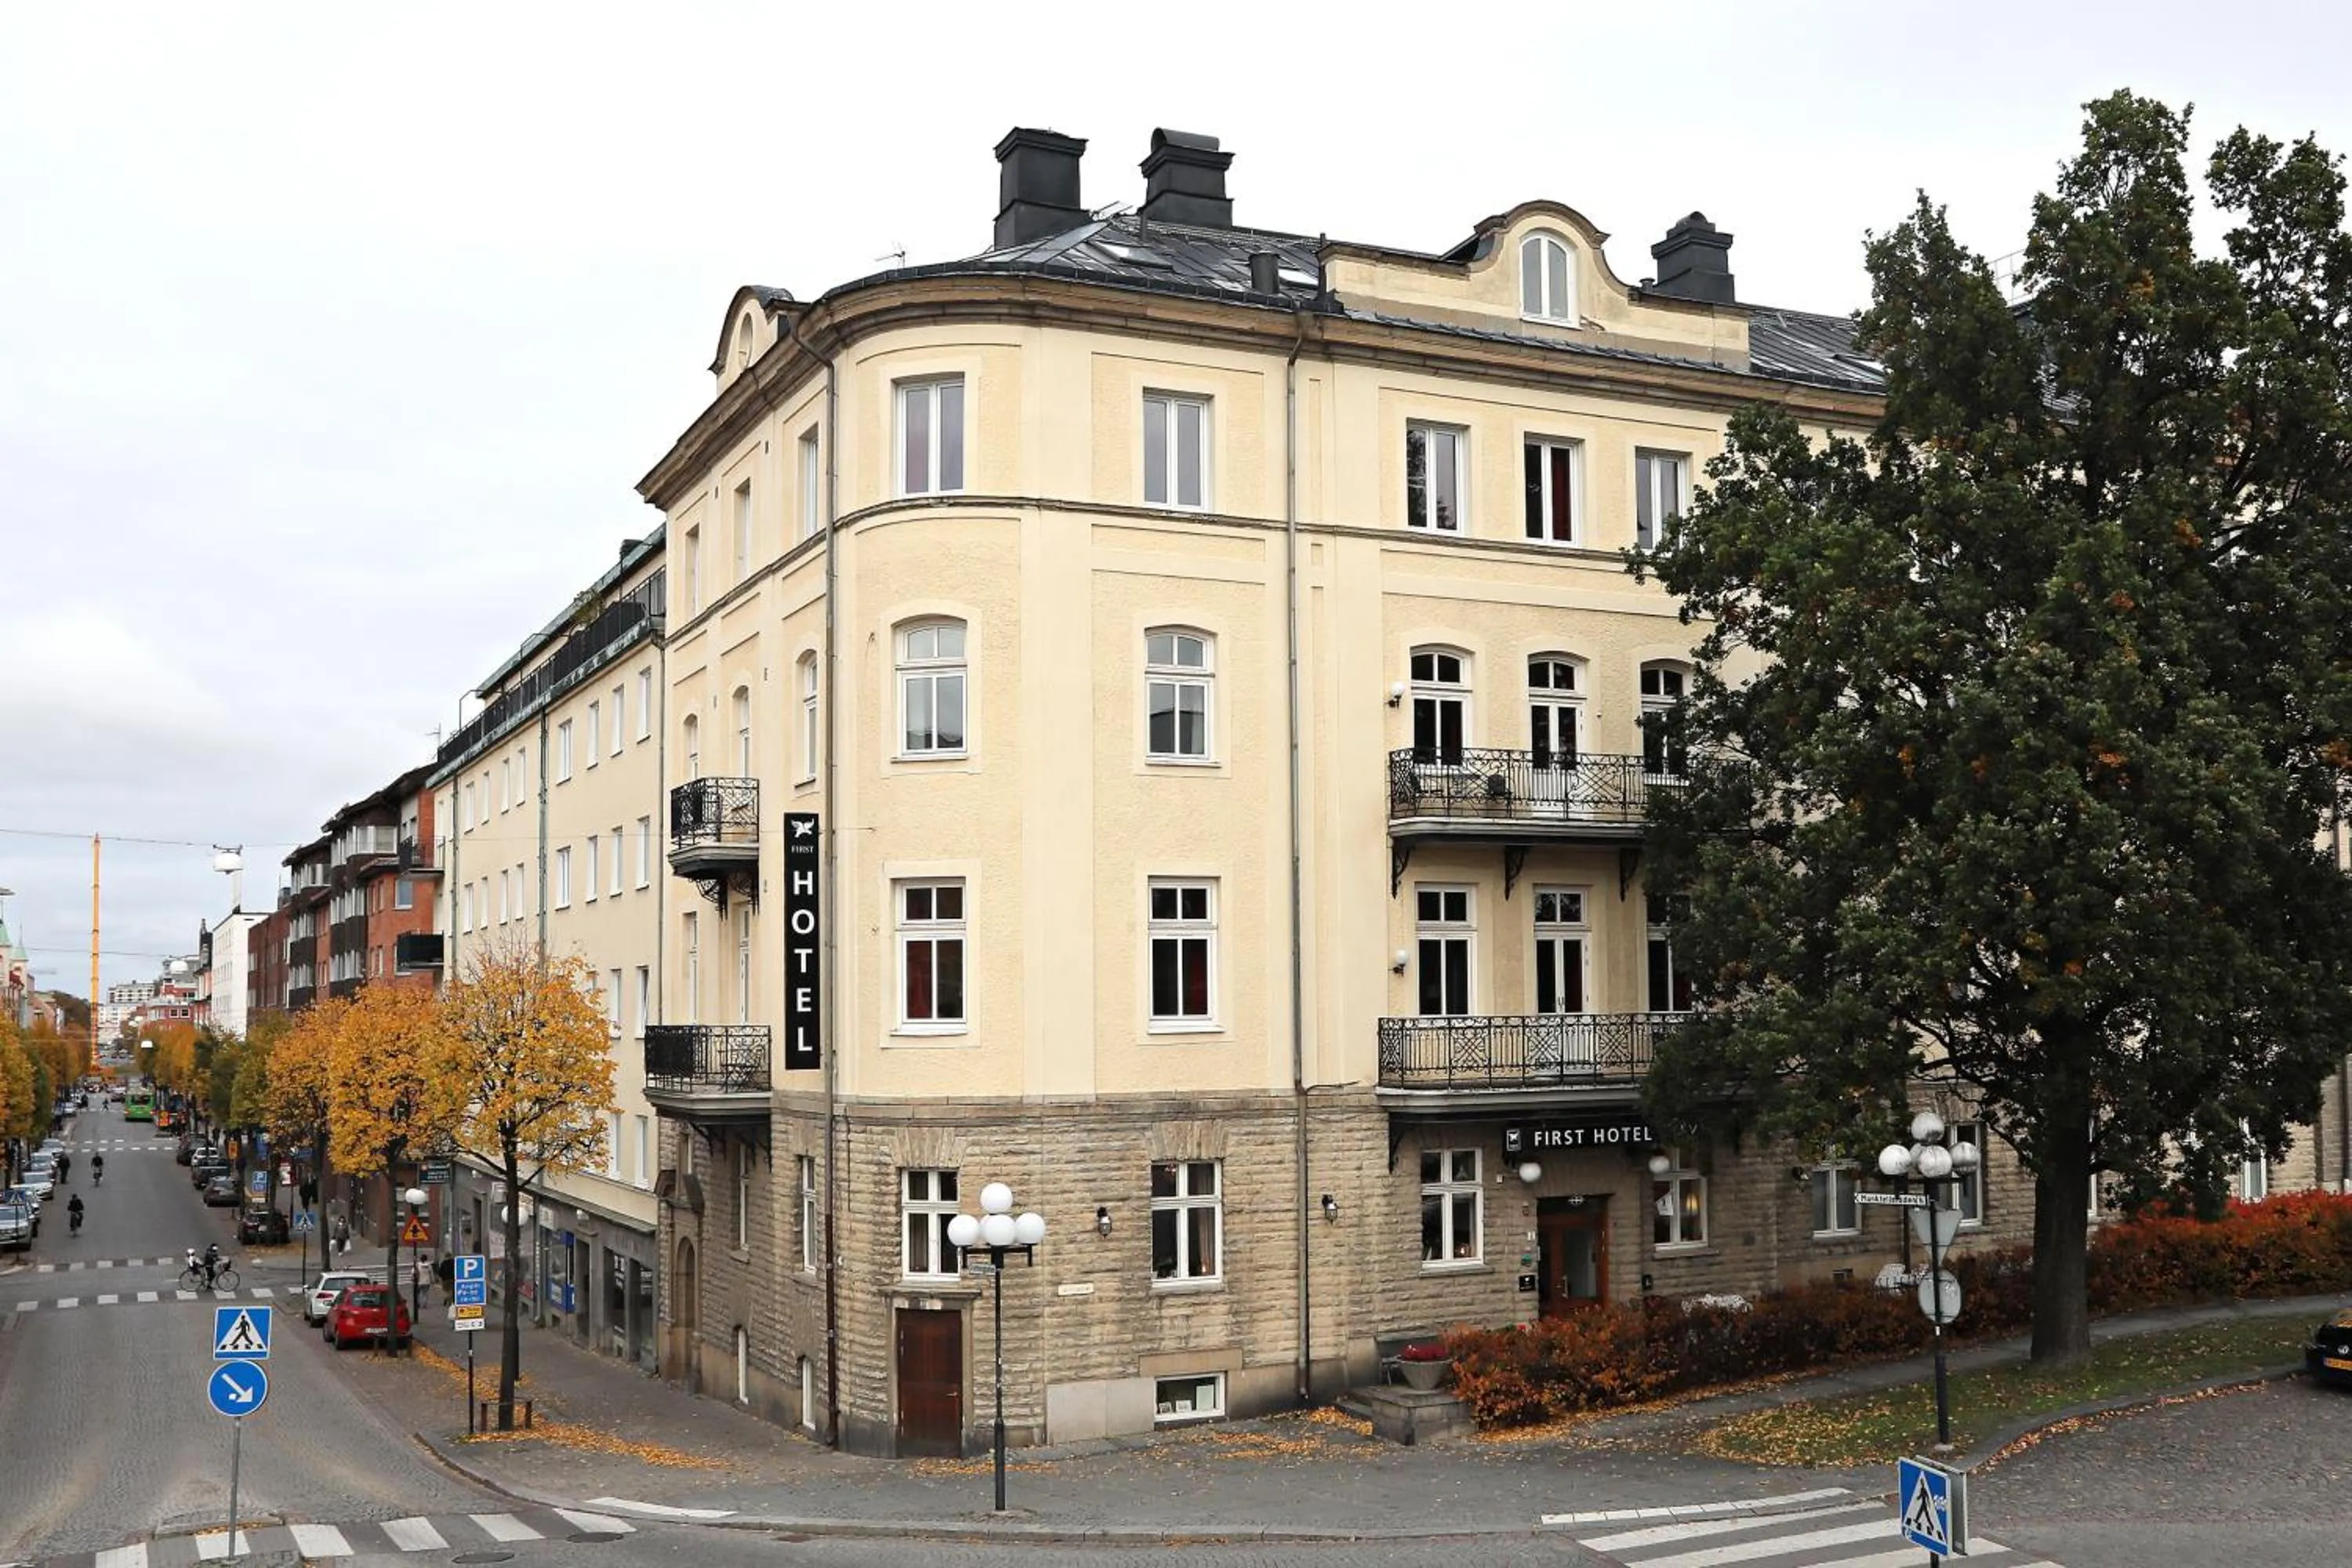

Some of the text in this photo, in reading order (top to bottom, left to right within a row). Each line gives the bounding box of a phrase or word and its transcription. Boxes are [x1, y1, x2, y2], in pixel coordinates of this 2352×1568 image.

[791, 845, 814, 854] FIRST
[791, 870, 815, 1051] HOTEL
[1534, 1129, 1584, 1146] FIRST
[1594, 1126, 1653, 1144] HOTEL
[464, 1258, 477, 1278] P
